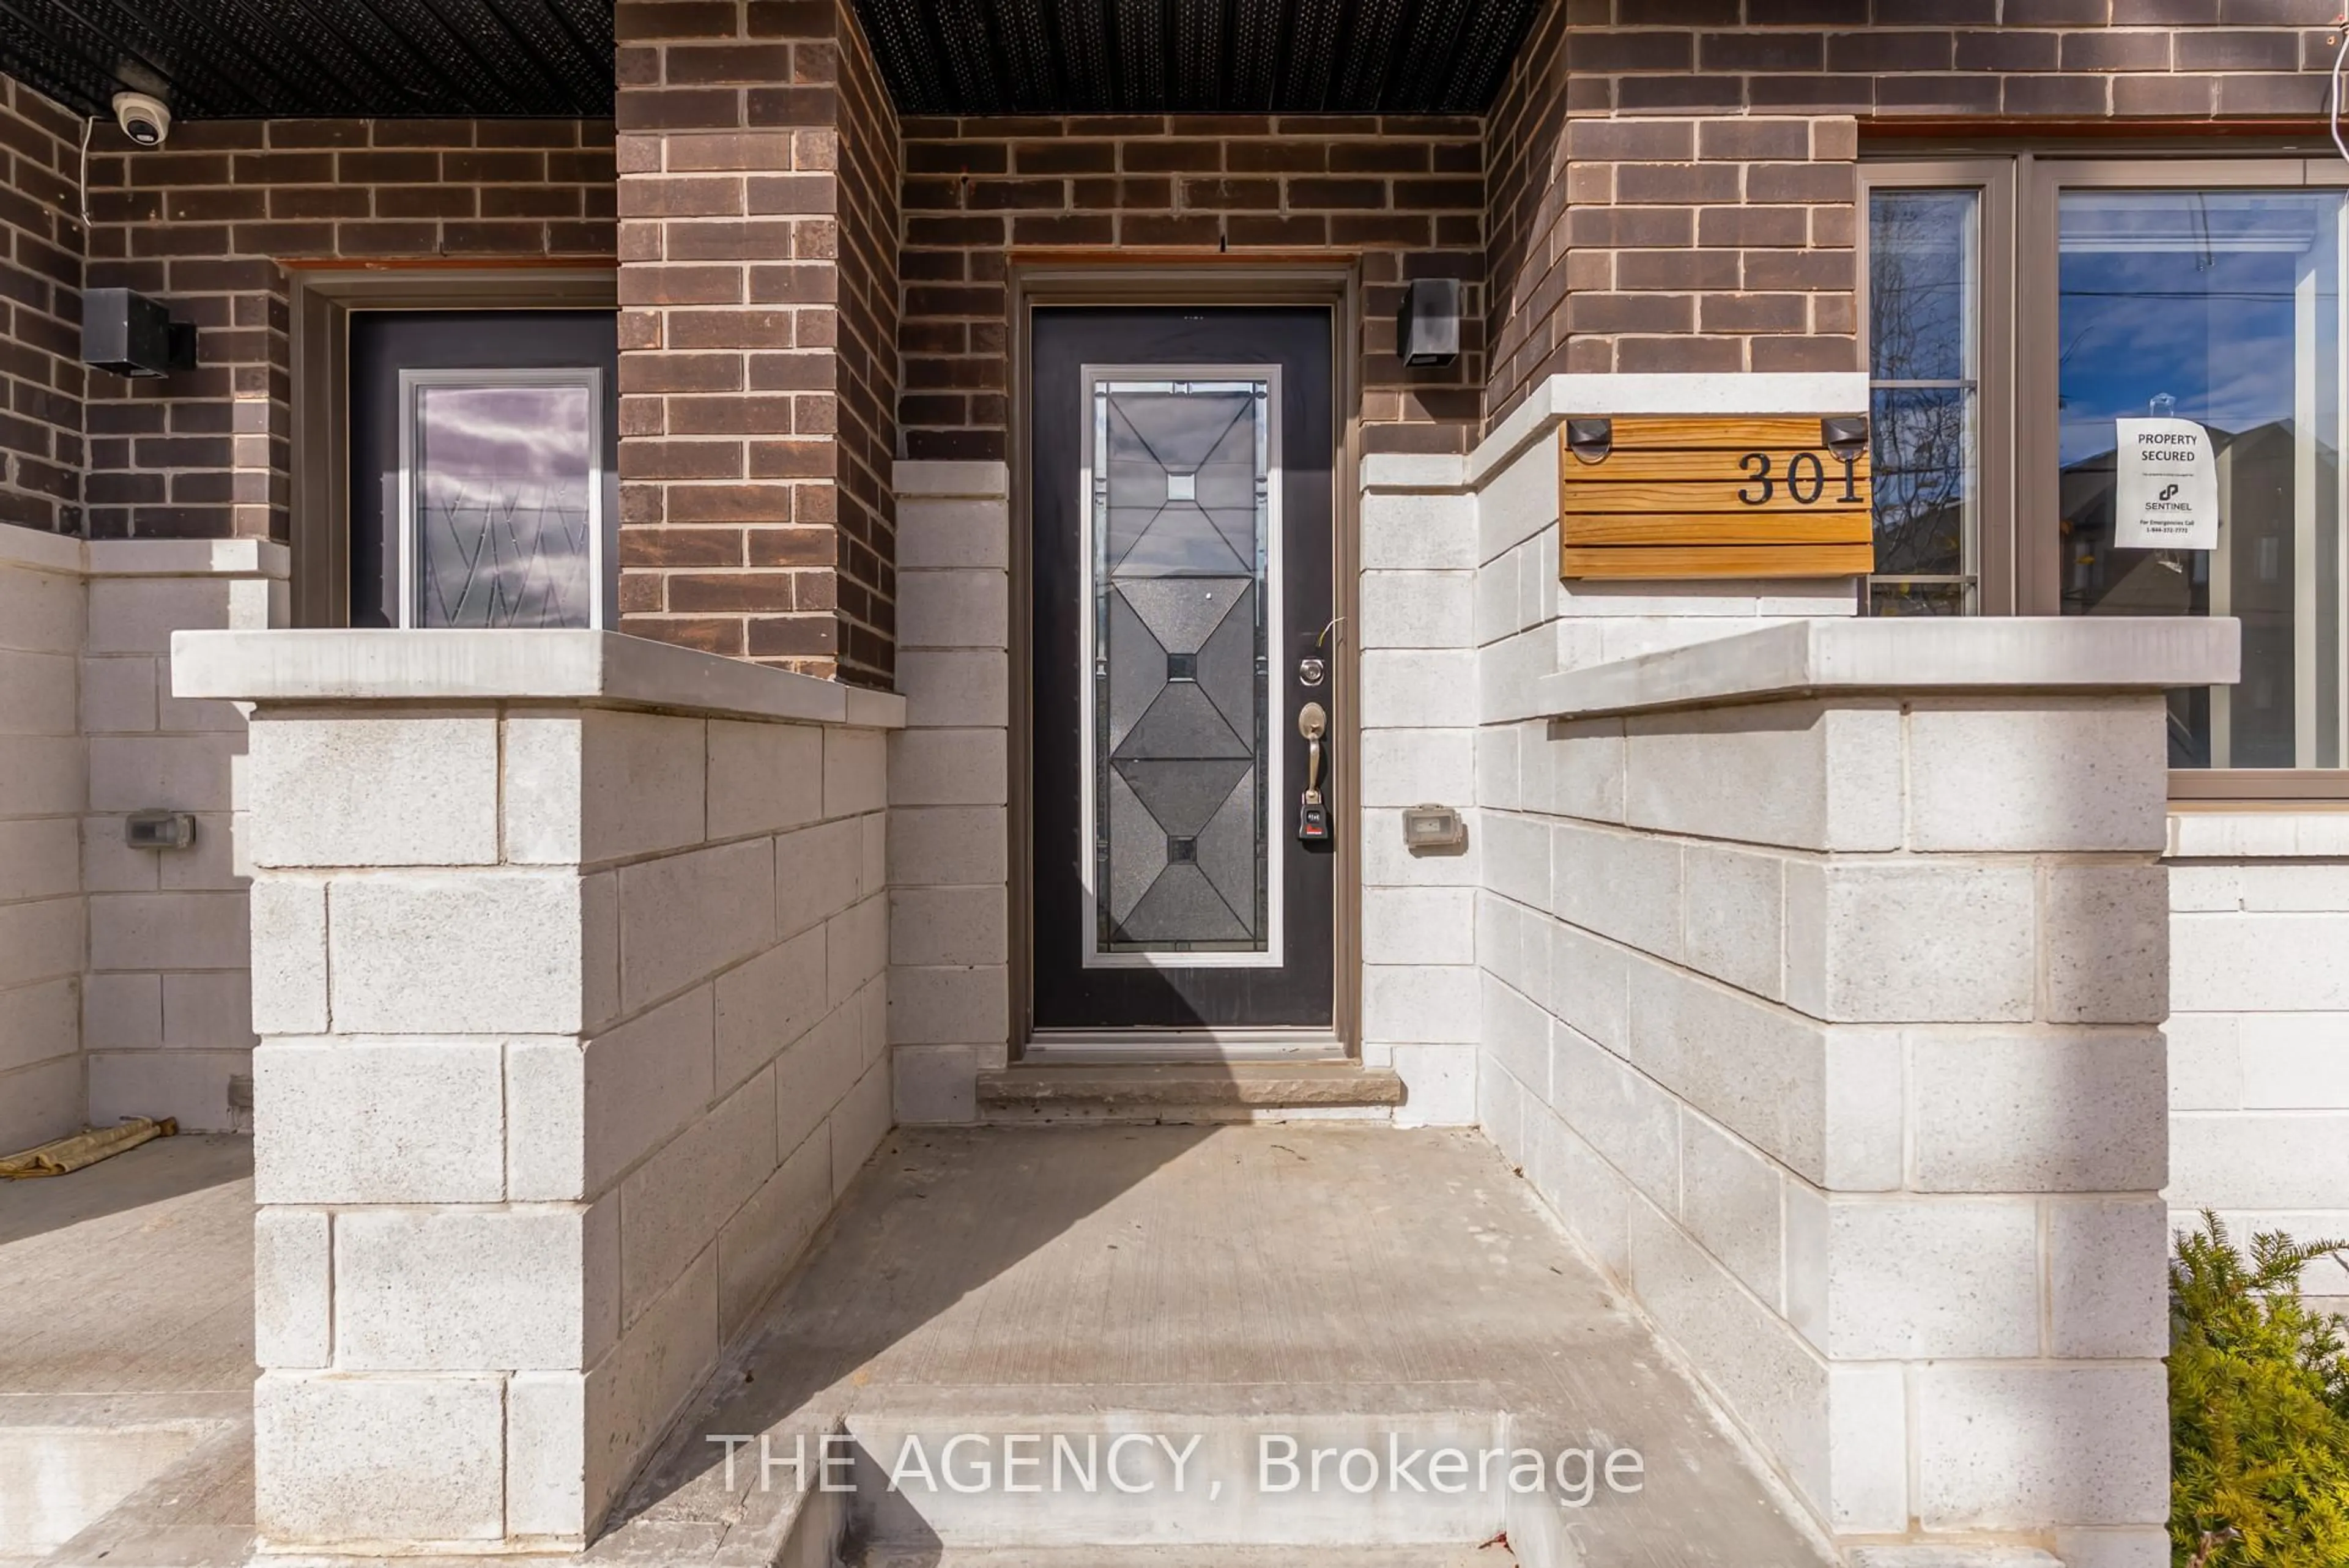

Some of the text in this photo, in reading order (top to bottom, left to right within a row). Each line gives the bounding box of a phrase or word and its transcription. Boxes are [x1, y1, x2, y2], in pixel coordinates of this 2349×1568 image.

[2139, 434, 2197, 445] PROPERTY
[2142, 451, 2195, 461] SECURED
[1737, 452, 1864, 506] 301
[2145, 502, 2192, 511] SENTINEL
